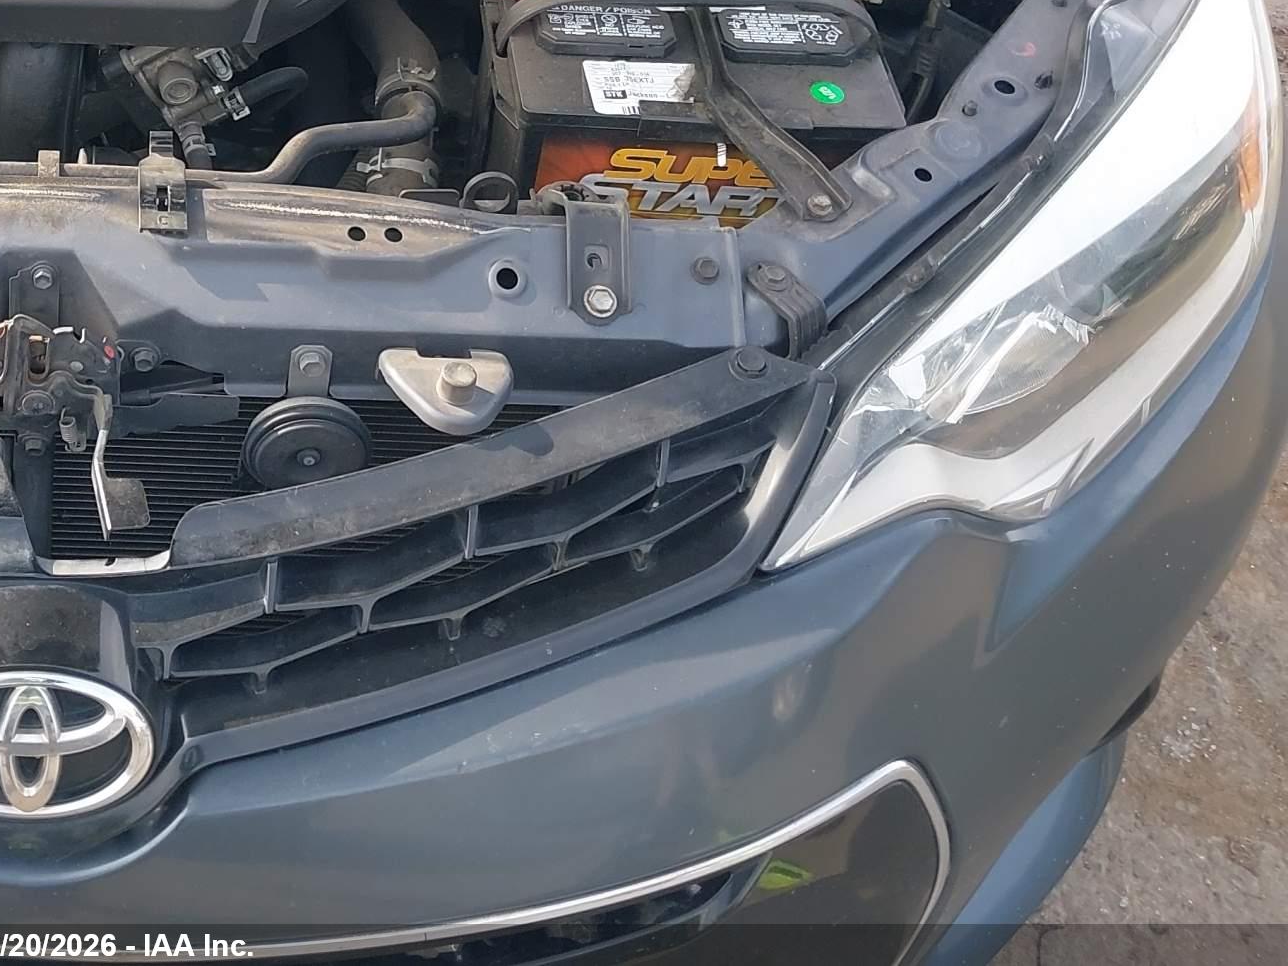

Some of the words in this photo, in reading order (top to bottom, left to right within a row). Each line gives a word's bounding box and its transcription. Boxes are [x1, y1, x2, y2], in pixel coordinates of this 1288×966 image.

[560, 4, 603, 13] DANGER
[613, 6, 652, 15] POISON
[603, 148, 778, 188] SUPE
